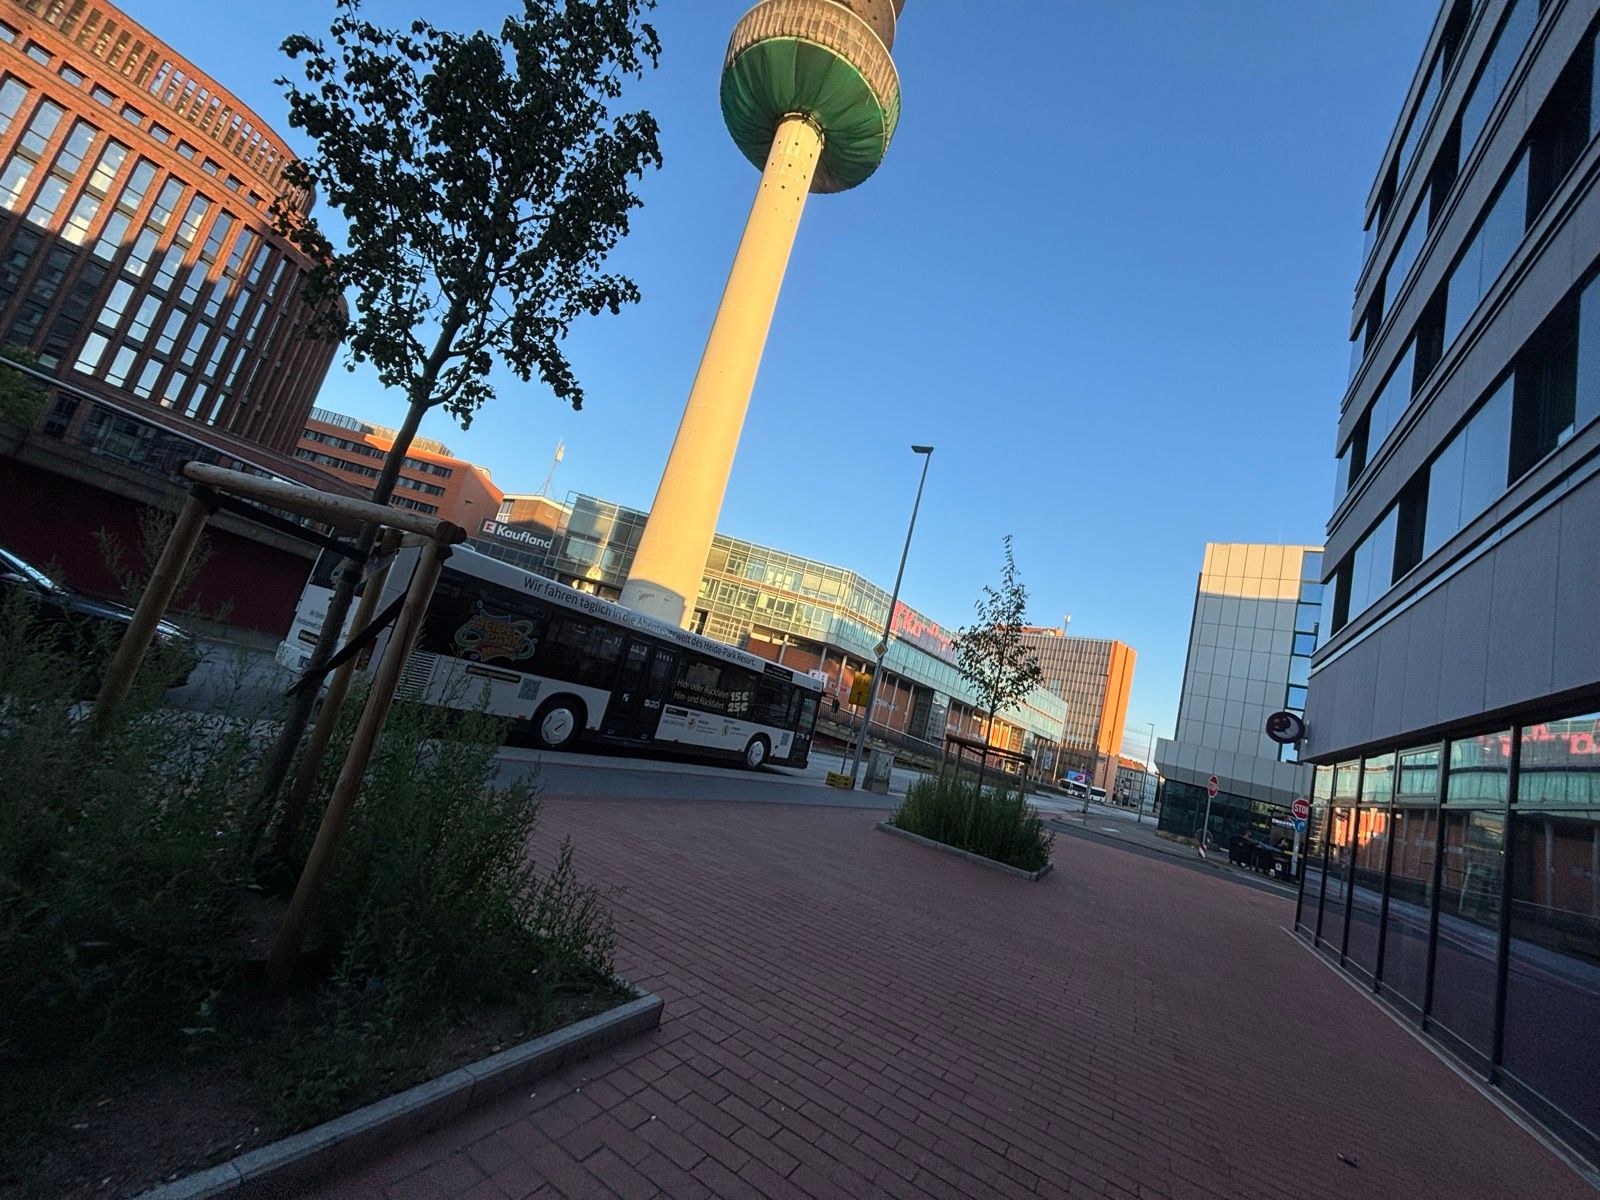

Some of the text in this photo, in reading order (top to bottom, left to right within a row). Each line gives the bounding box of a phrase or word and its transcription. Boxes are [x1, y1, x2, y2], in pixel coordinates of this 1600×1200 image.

[524, 576, 542, 592] Wir
[544, 583, 578, 605] fahren
[612, 607, 621, 620] in
[622, 610, 636, 625] die
[691, 635, 703, 649] des
